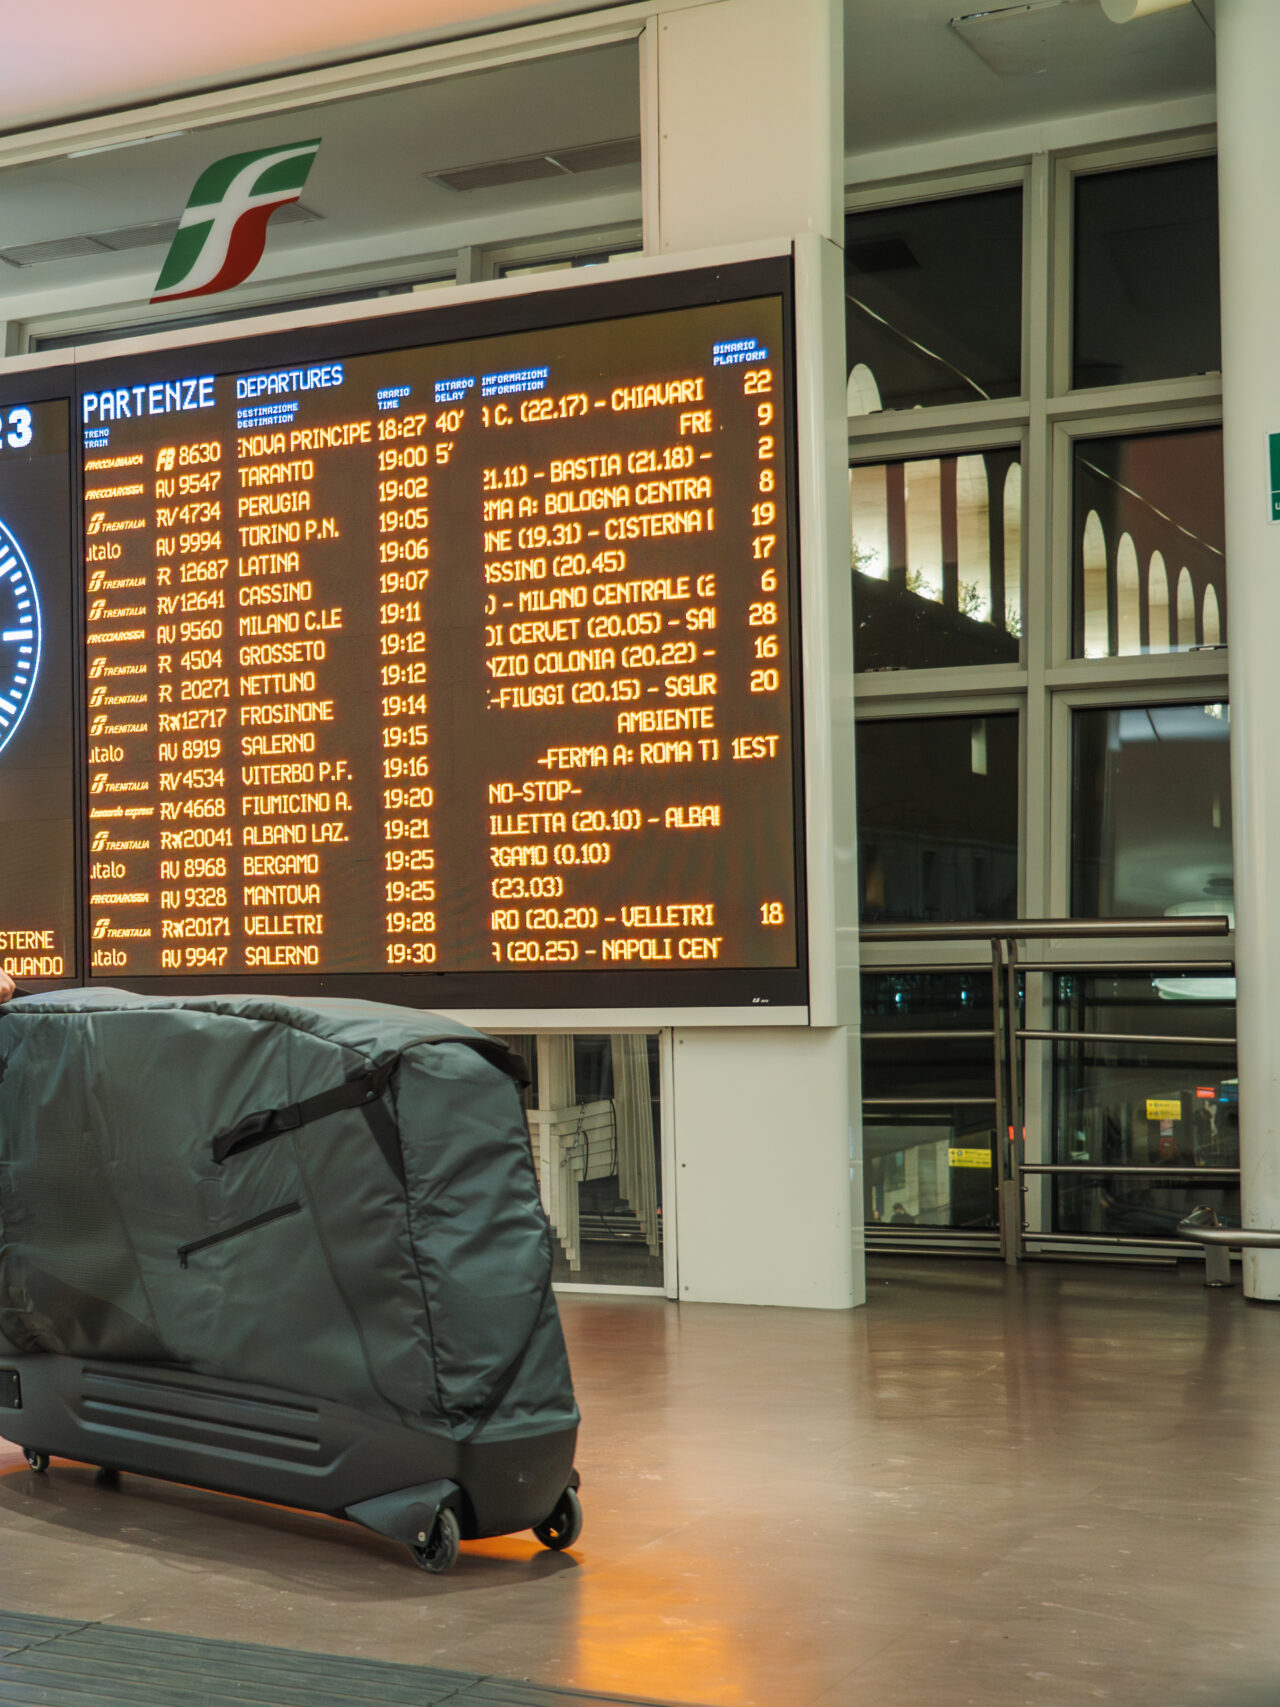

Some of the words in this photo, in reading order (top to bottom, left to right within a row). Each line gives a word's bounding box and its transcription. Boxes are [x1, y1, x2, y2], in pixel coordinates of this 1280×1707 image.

[712, 339, 755, 354] BINARIO
[713, 349, 766, 365] PLATFORM
[376, 386, 410, 399] ORARIO
[434, 378, 474, 392] RITARDO
[481, 367, 548, 385] INFORMAZIONI
[481, 379, 544, 396] INFORMATION
[82, 376, 215, 423] PARTENZE
[236, 364, 343, 399] DEPARTURES
[236, 402, 298, 418] DESTINAZIONE
[377, 398, 399, 410] TIME
[434, 390, 464, 402] DELAY
[83, 427, 109, 439] TRENO
[178, 440, 221, 466] 8630
[289, 420, 371, 452] PRINCIPE
[376, 413, 427, 440] 18:27
[520, 393, 588, 422] (22.17)
[610, 377, 703, 411] CHIAVARI
[743, 368, 771, 394] 22
[237, 413, 293, 429] DESTINATION
[83, 438, 108, 448] TRAIN
[154, 477, 175, 499] AV
[178, 470, 221, 495] 9547
[237, 459, 314, 487] TARANTO
[377, 444, 427, 471] 19:00
[757, 402, 773, 426] 9
[237, 489, 310, 518] PERUGIA
[378, 476, 428, 502] 19:02
[549, 453, 621, 483] BASTIA
[627, 444, 694, 474] (21.18)
[758, 435, 773, 459] 2
[155, 536, 175, 557] AV
[179, 530, 221, 553] 9994
[237, 521, 300, 547] TORINO
[304, 517, 339, 540] P.N.
[378, 506, 428, 532] 19:05
[544, 484, 630, 515] BOLOGNA
[634, 475, 711, 505] CENTRA
[758, 468, 774, 492] 8
[156, 566, 171, 586] R
[179, 558, 228, 583] 12687
[238, 550, 299, 577] LATINA
[379, 537, 429, 563] 19:06
[517, 521, 581, 549] (19.31)
[604, 508, 702, 540] CISTERNA
[751, 501, 775, 526] 19
[238, 580, 312, 606] CASSINO
[379, 568, 429, 593] 19:07
[552, 549, 625, 577] (20.45)
[751, 534, 775, 559] 17
[156, 624, 176, 644] AV
[179, 618, 222, 642] 9560
[238, 611, 299, 636] MILANO
[303, 607, 342, 631] C.LE
[379, 600, 421, 624] 19:11
[518, 585, 587, 612] MILANO
[592, 575, 690, 606] CENTRALE
[760, 568, 776, 591] 6
[157, 654, 172, 673] R
[180, 648, 222, 670] 4504
[238, 639, 325, 666] GROSSETO
[379, 630, 425, 655] 19:12
[508, 617, 580, 645] CERVET
[586, 611, 661, 638] (20.05)
[748, 601, 777, 625] 28
[157, 683, 172, 703] R
[180, 677, 230, 700] 20271
[239, 670, 315, 696] NETTUNO
[380, 661, 426, 685] 19:12
[533, 647, 615, 674] COLONIA
[621, 640, 696, 668] (20.22)
[753, 634, 778, 658] 16
[240, 699, 334, 726] FROSINONE
[381, 693, 427, 716] 19:14
[571, 678, 640, 703] (20.15)
[664, 672, 717, 697] SGUR
[750, 668, 779, 692] 20
[158, 741, 178, 761] AV
[181, 737, 221, 759] 8919
[240, 731, 315, 756] SALERNO
[382, 724, 428, 747] 19:15
[617, 705, 714, 733] AMBIENTE
[241, 762, 314, 785] VITERBO
[318, 760, 352, 781] P.F.
[382, 755, 428, 778] 19:16
[639, 739, 692, 764] ROMA
[241, 791, 330, 816] FIUMICINO
[383, 786, 433, 809] 19:20
[242, 823, 307, 845] ALBANO
[311, 821, 349, 843] LAZ.
[383, 818, 429, 840] 19:21
[489, 811, 566, 835] ILLETTA
[571, 808, 641, 832] (20.10)
[160, 860, 180, 879] AV
[183, 856, 226, 878] 8968
[243, 853, 319, 876] BERGAMO
[384, 848, 434, 871] 19:25
[553, 842, 610, 865] (0.10)
[160, 889, 180, 909] AV
[184, 886, 227, 907] 9328
[243, 883, 320, 905] MANTOVA
[384, 879, 435, 902] 19:25
[491, 875, 563, 899] (23.03)
[243, 913, 323, 935] VELLETRI
[385, 910, 436, 932] 19:28
[525, 906, 598, 929] (20.20)
[620, 903, 714, 927] VELLETRI
[759, 901, 783, 924] 18
[4, 957, 63, 976] QUANDO
[161, 948, 181, 968] AV
[184, 946, 228, 967] 9947
[244, 944, 319, 966] SALERNO
[386, 942, 436, 963] 19:30
[506, 939, 578, 961] (20.25)
[601, 937, 672, 960] NAPOLI
